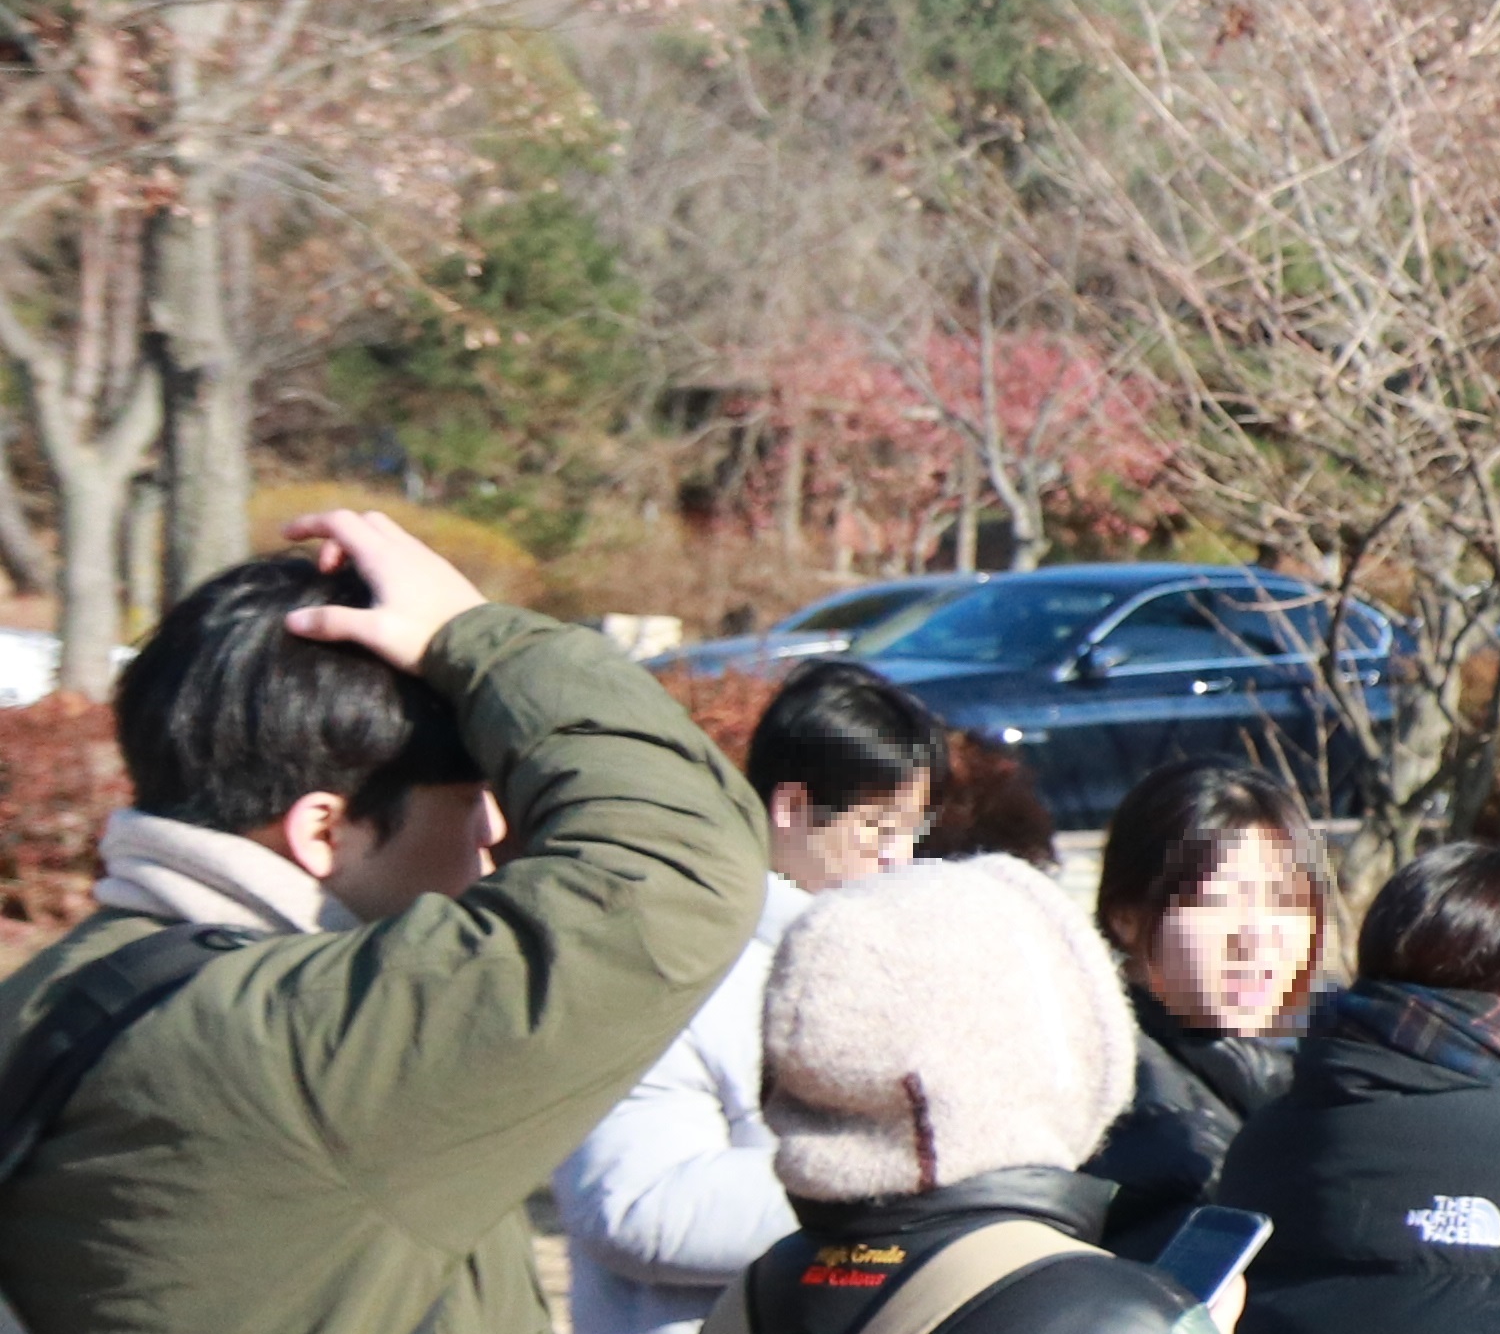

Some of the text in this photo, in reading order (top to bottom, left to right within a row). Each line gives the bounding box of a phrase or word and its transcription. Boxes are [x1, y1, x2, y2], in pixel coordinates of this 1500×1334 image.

[1433, 1195, 1472, 1211] THE
[1405, 1208, 1471, 1229] NORTH
[1422, 1223, 1471, 1245] FACE
